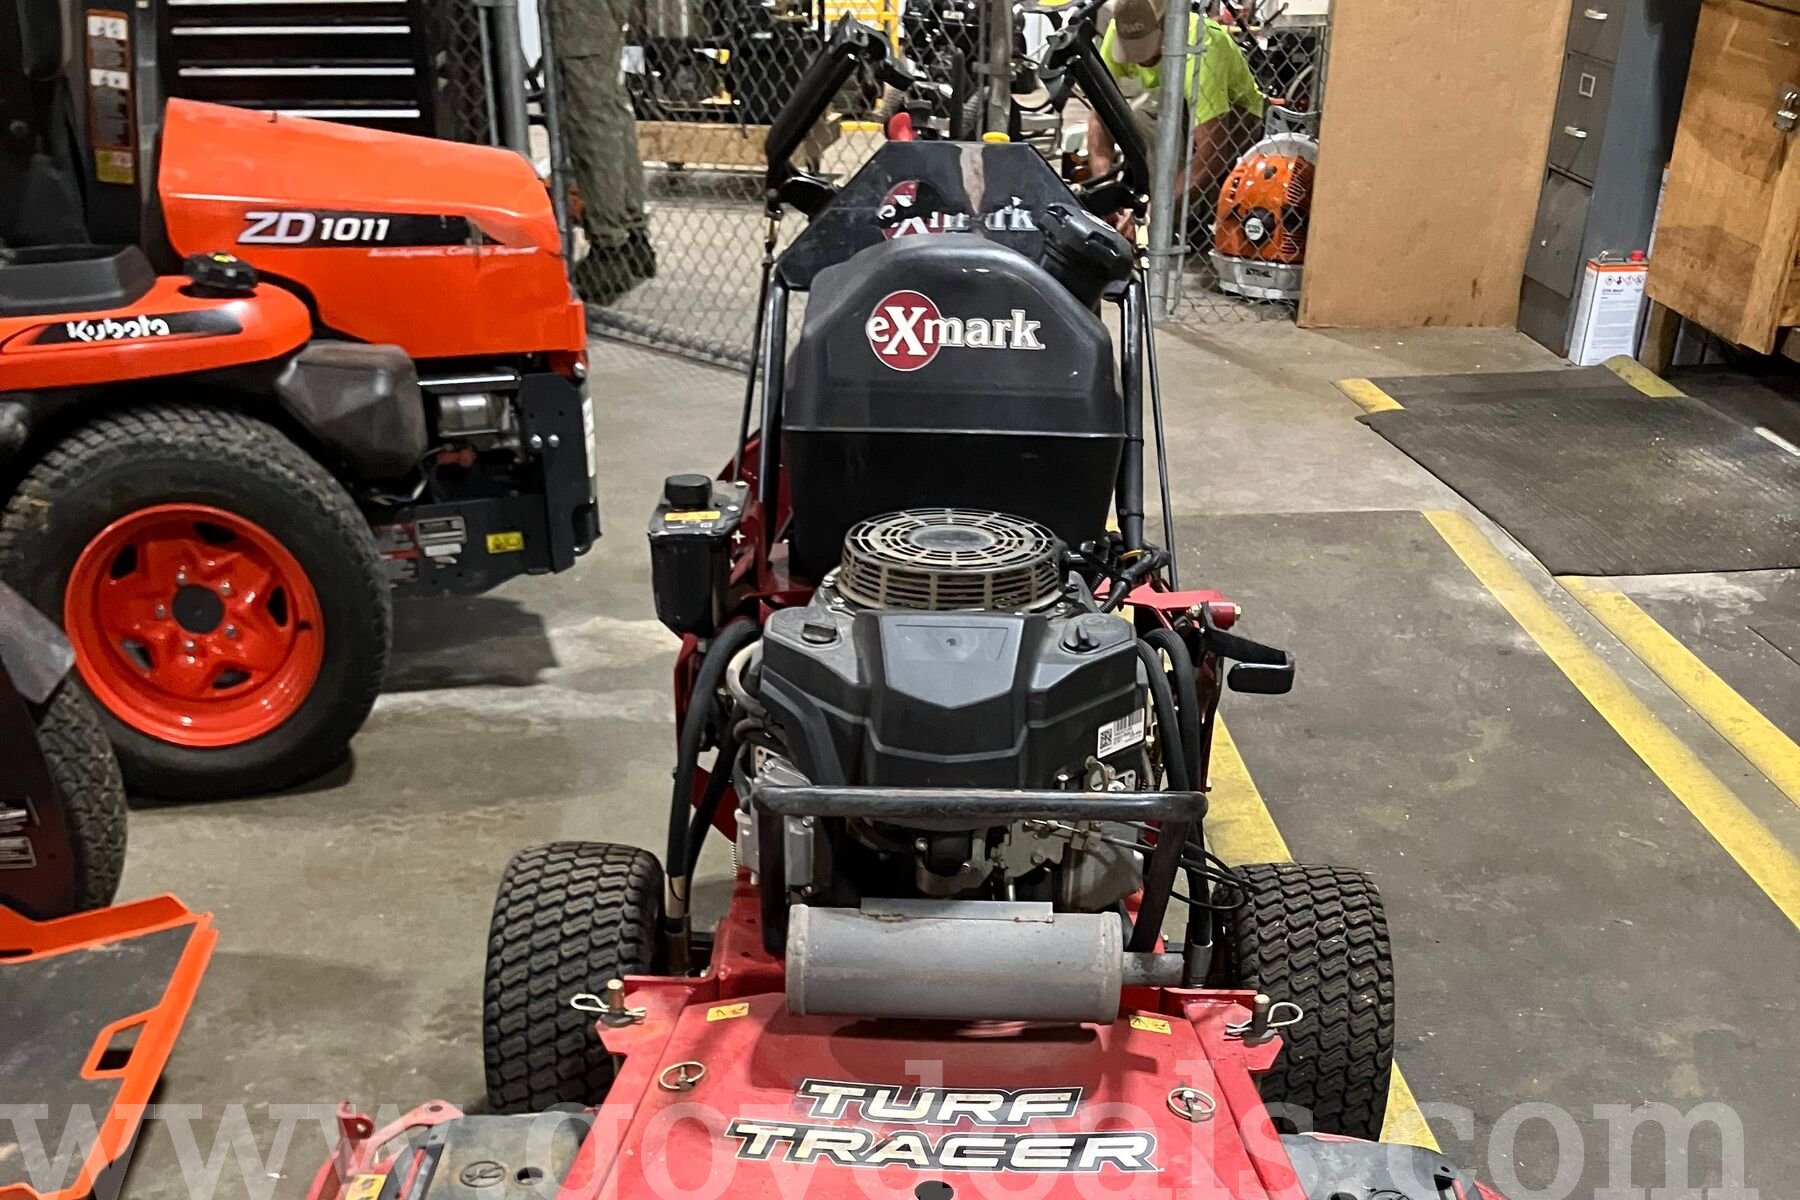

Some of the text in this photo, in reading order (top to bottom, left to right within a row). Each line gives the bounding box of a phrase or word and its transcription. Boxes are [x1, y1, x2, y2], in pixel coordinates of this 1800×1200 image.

[237, 212, 390, 244] ZD 1011
[66, 314, 170, 342] Kubota
[866, 305, 1043, 357] eXmark
[798, 1078, 1083, 1127] TURF
[725, 1118, 1164, 1172] TRACER
